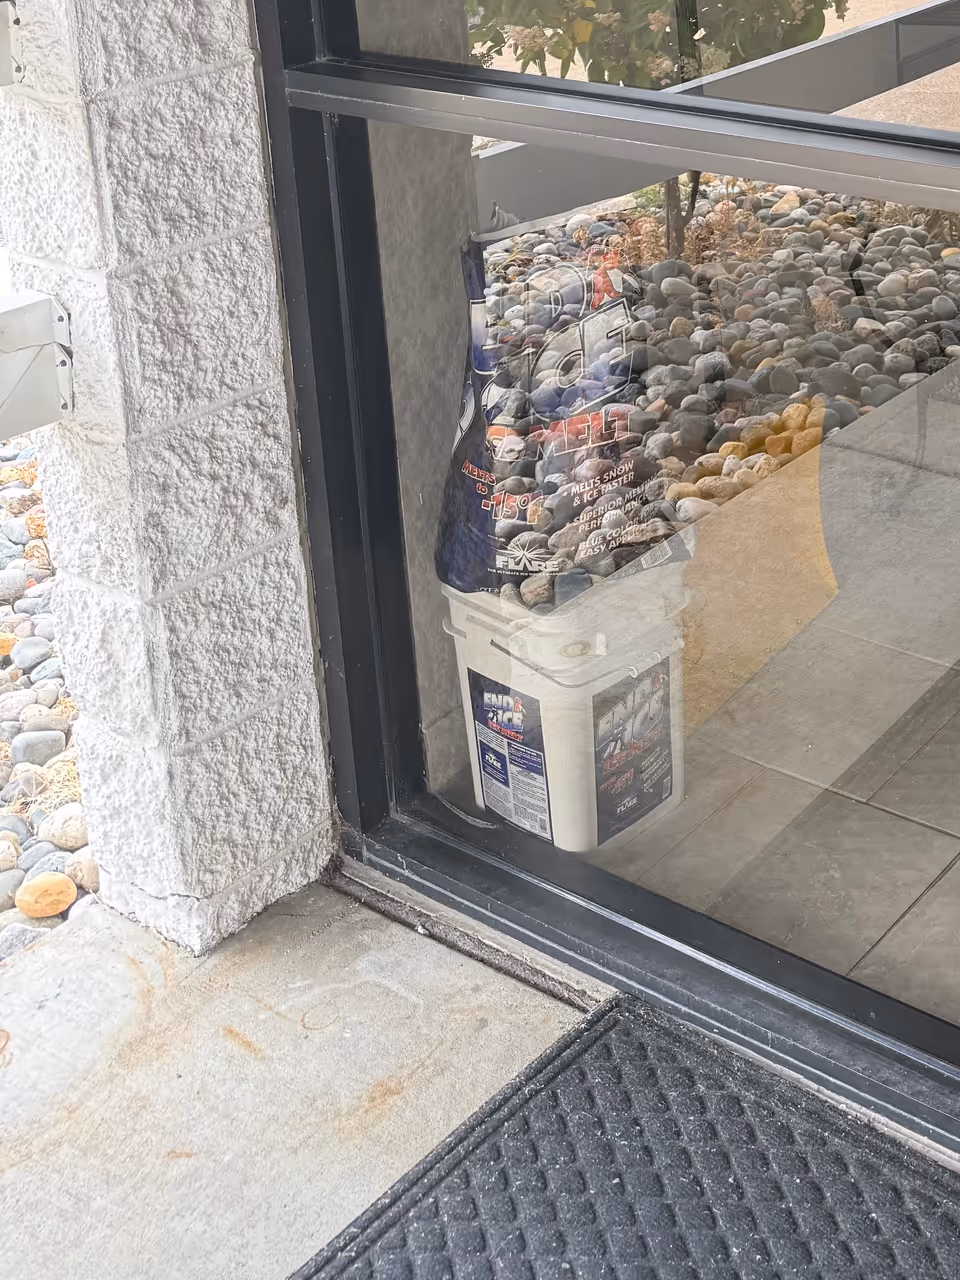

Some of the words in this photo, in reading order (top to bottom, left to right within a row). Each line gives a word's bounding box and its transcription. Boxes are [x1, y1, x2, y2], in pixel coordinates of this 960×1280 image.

[528, 407, 634, 462] MELT
[461, 460, 497, 486] MELTS
[571, 475, 601, 496] MELTS
[603, 460, 635, 482] SNOW
[476, 482, 489, 495] to
[573, 497, 581, 507] &
[583, 488, 599, 503] ICE
[601, 471, 635, 495] FASTER
[573, 497, 623, 523] SUPERIOR
[579, 534, 604, 550] BLUE
[606, 517, 639, 540] COLOR
[494, 554, 560, 572] FLARE
[580, 543, 607, 558] EASY
